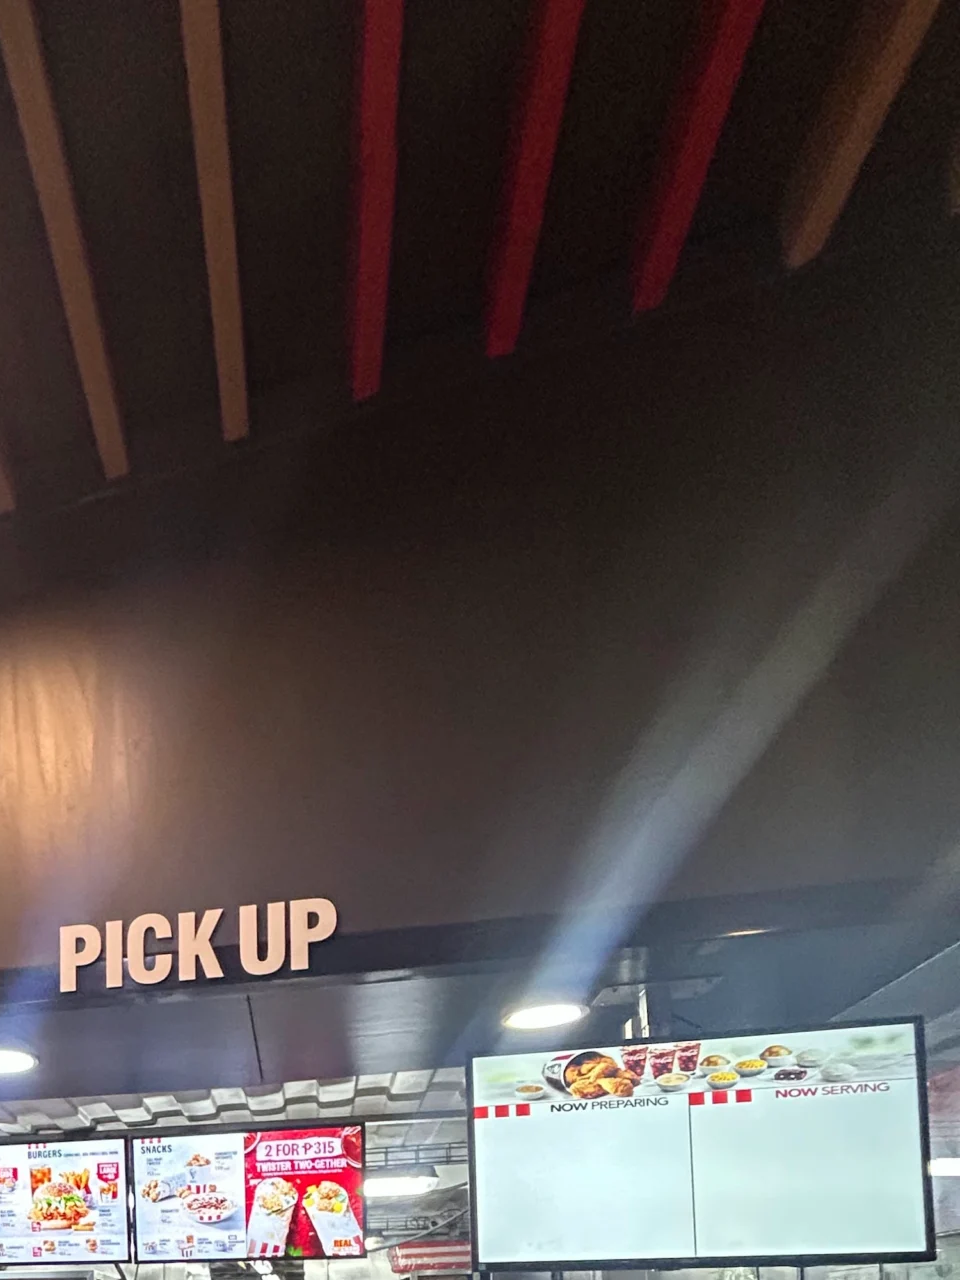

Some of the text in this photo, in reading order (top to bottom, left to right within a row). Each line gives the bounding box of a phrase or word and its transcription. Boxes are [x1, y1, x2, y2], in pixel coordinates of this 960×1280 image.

[60, 898, 337, 992] PICK UP
[775, 1081, 891, 1100] NOW SERVING
[550, 1096, 670, 1113] NOW PREPARING
[27, 1150, 62, 1159] BURGERS
[140, 1144, 172, 1155] SNACKS
[264, 1145, 273, 1157] 2
[276, 1143, 299, 1157] FOR
[255, 1160, 292, 1173] TWISTER
[293, 1158, 348, 1170] TWO-GETHER
